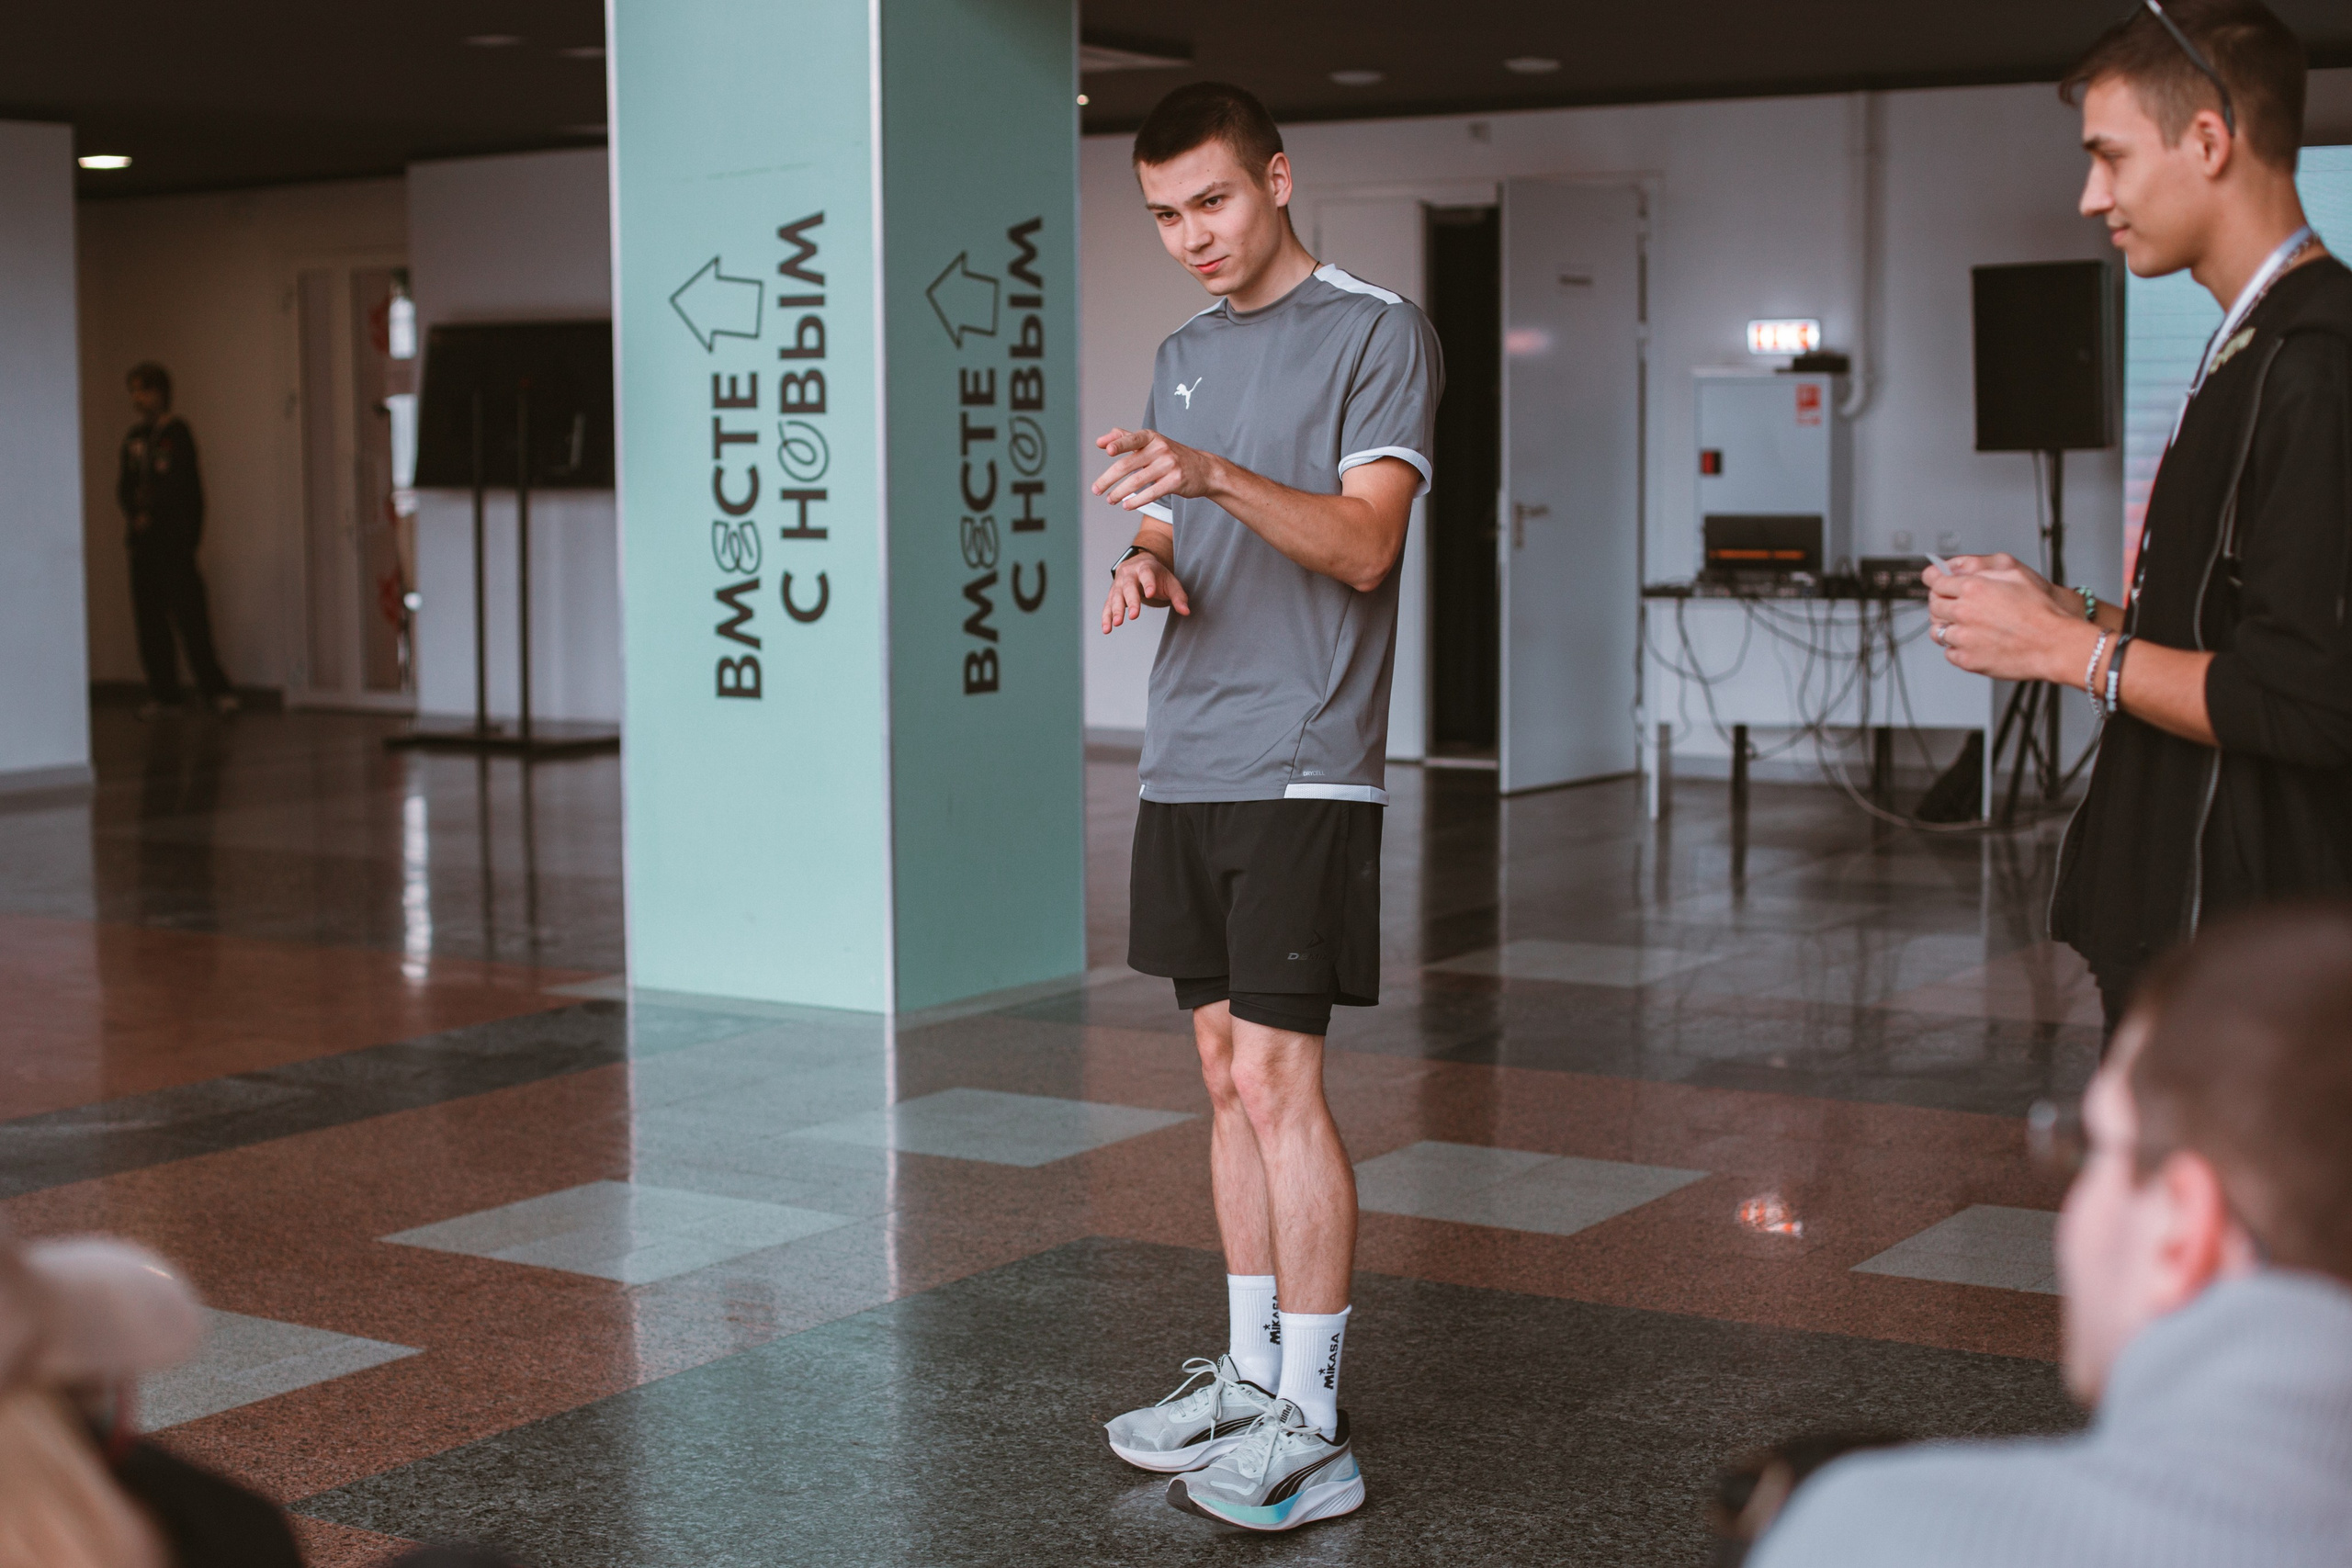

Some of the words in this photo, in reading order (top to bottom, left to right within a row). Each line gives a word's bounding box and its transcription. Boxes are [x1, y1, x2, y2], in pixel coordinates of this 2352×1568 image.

[777, 210, 828, 540] НОВЫМ
[711, 372, 763, 699] ВМЕСТЕ
[781, 570, 829, 623] С
[1012, 560, 1046, 614] С
